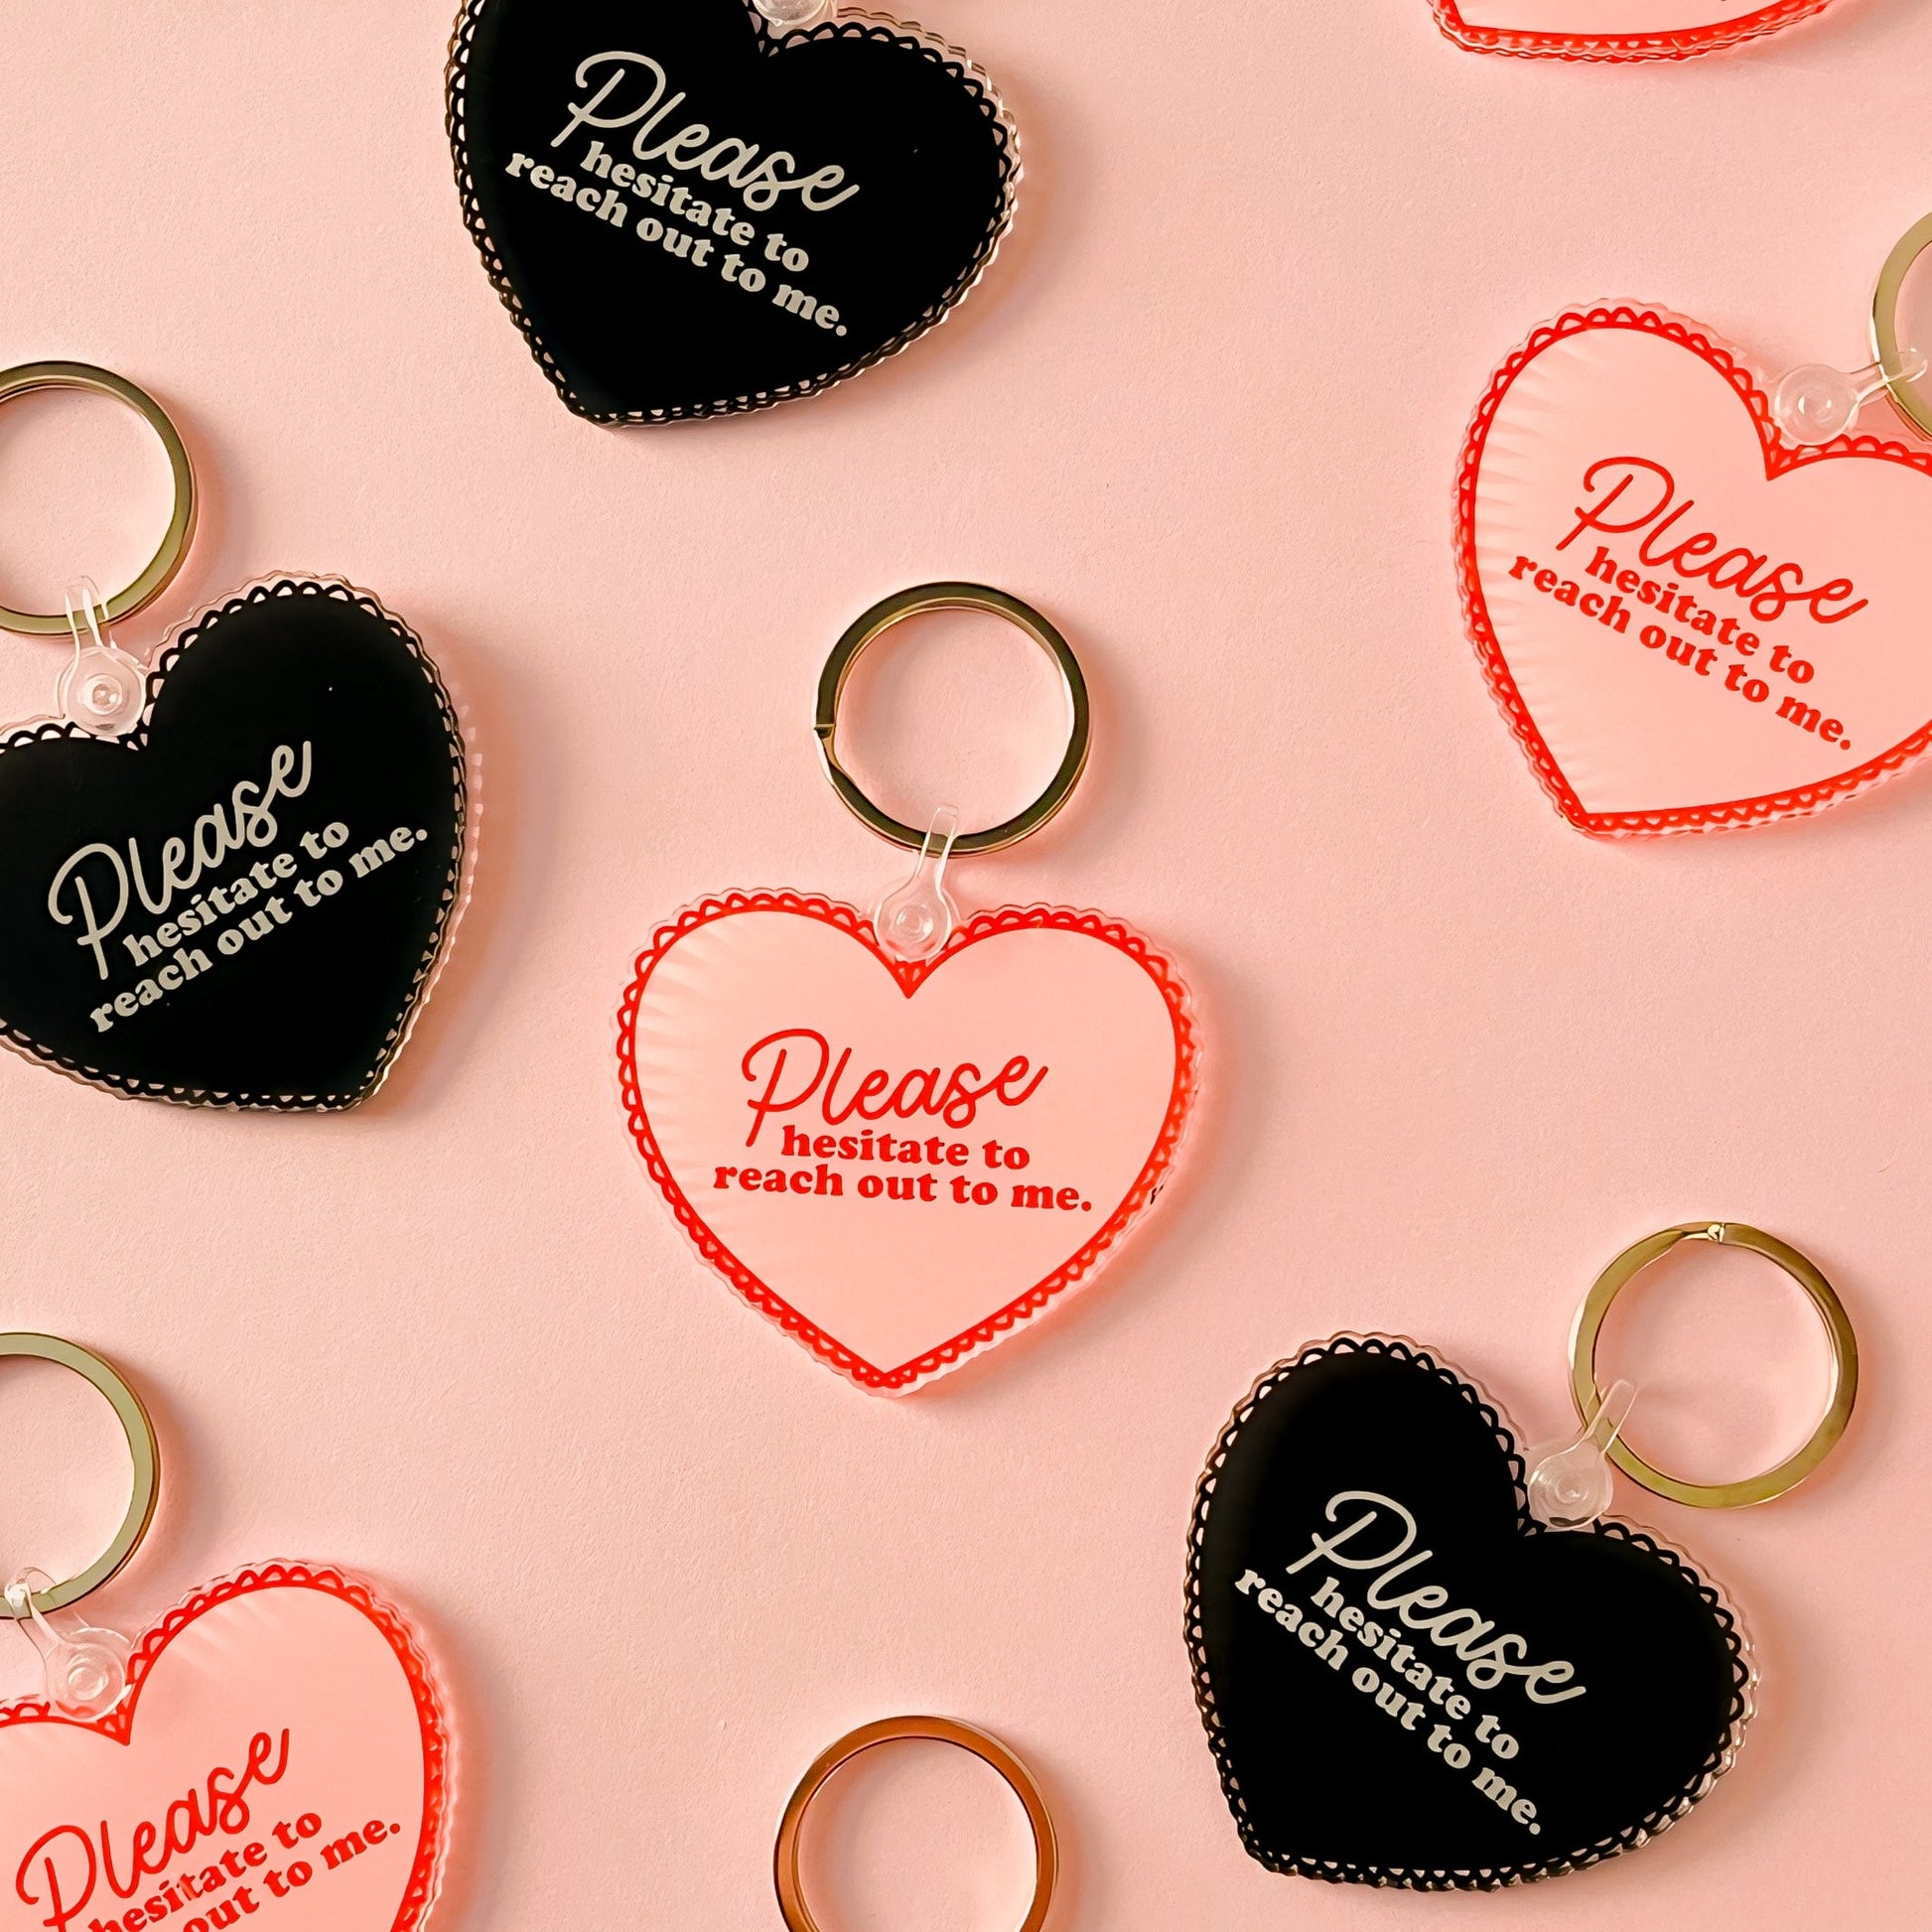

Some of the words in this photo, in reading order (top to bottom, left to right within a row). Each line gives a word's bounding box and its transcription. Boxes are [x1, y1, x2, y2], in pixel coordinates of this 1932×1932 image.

[550, 51, 860, 211] Please
[579, 140, 756, 246] hesitate
[763, 232, 809, 272] to
[504, 152, 628, 228] reach
[635, 217, 715, 267] out
[721, 253, 766, 293] to
[771, 284, 848, 337] me.
[1556, 456, 1868, 624] Please
[1585, 545, 1760, 656] hesitate
[1769, 644, 1815, 684] to
[1509, 555, 1631, 633] reach
[1639, 624, 1718, 676] out
[1725, 663, 1770, 703] to
[1775, 696, 1851, 751] me.
[48, 740, 312, 981] Please
[89, 947, 213, 1033] reach
[216, 896, 293, 955] out
[293, 869, 344, 907] to
[348, 826, 428, 879] me.
[122, 853, 298, 967] hesitate
[299, 821, 349, 860] to
[741, 1028, 1048, 1148] Please
[780, 1124, 970, 1167] hesitate
[982, 1140, 1031, 1171] to
[714, 1163, 843, 1197] reach
[857, 1173, 936, 1202] out
[949, 1175, 999, 1206] to
[1011, 1184, 1092, 1212] me.
[1285, 1490, 1587, 1705] Please
[1310, 1576, 1471, 1721] hesitate
[1474, 1714, 1520, 1759] to
[1234, 1569, 1349, 1671] reach
[1351, 1667, 1427, 1731] out
[1427, 1724, 1471, 1769] to
[1471, 1766, 1541, 1836] me.
[15, 1727, 290, 1932] Please
[263, 1861, 313, 1898] to
[320, 1819, 401, 1870] me.
[271, 1812, 323, 1850] to
